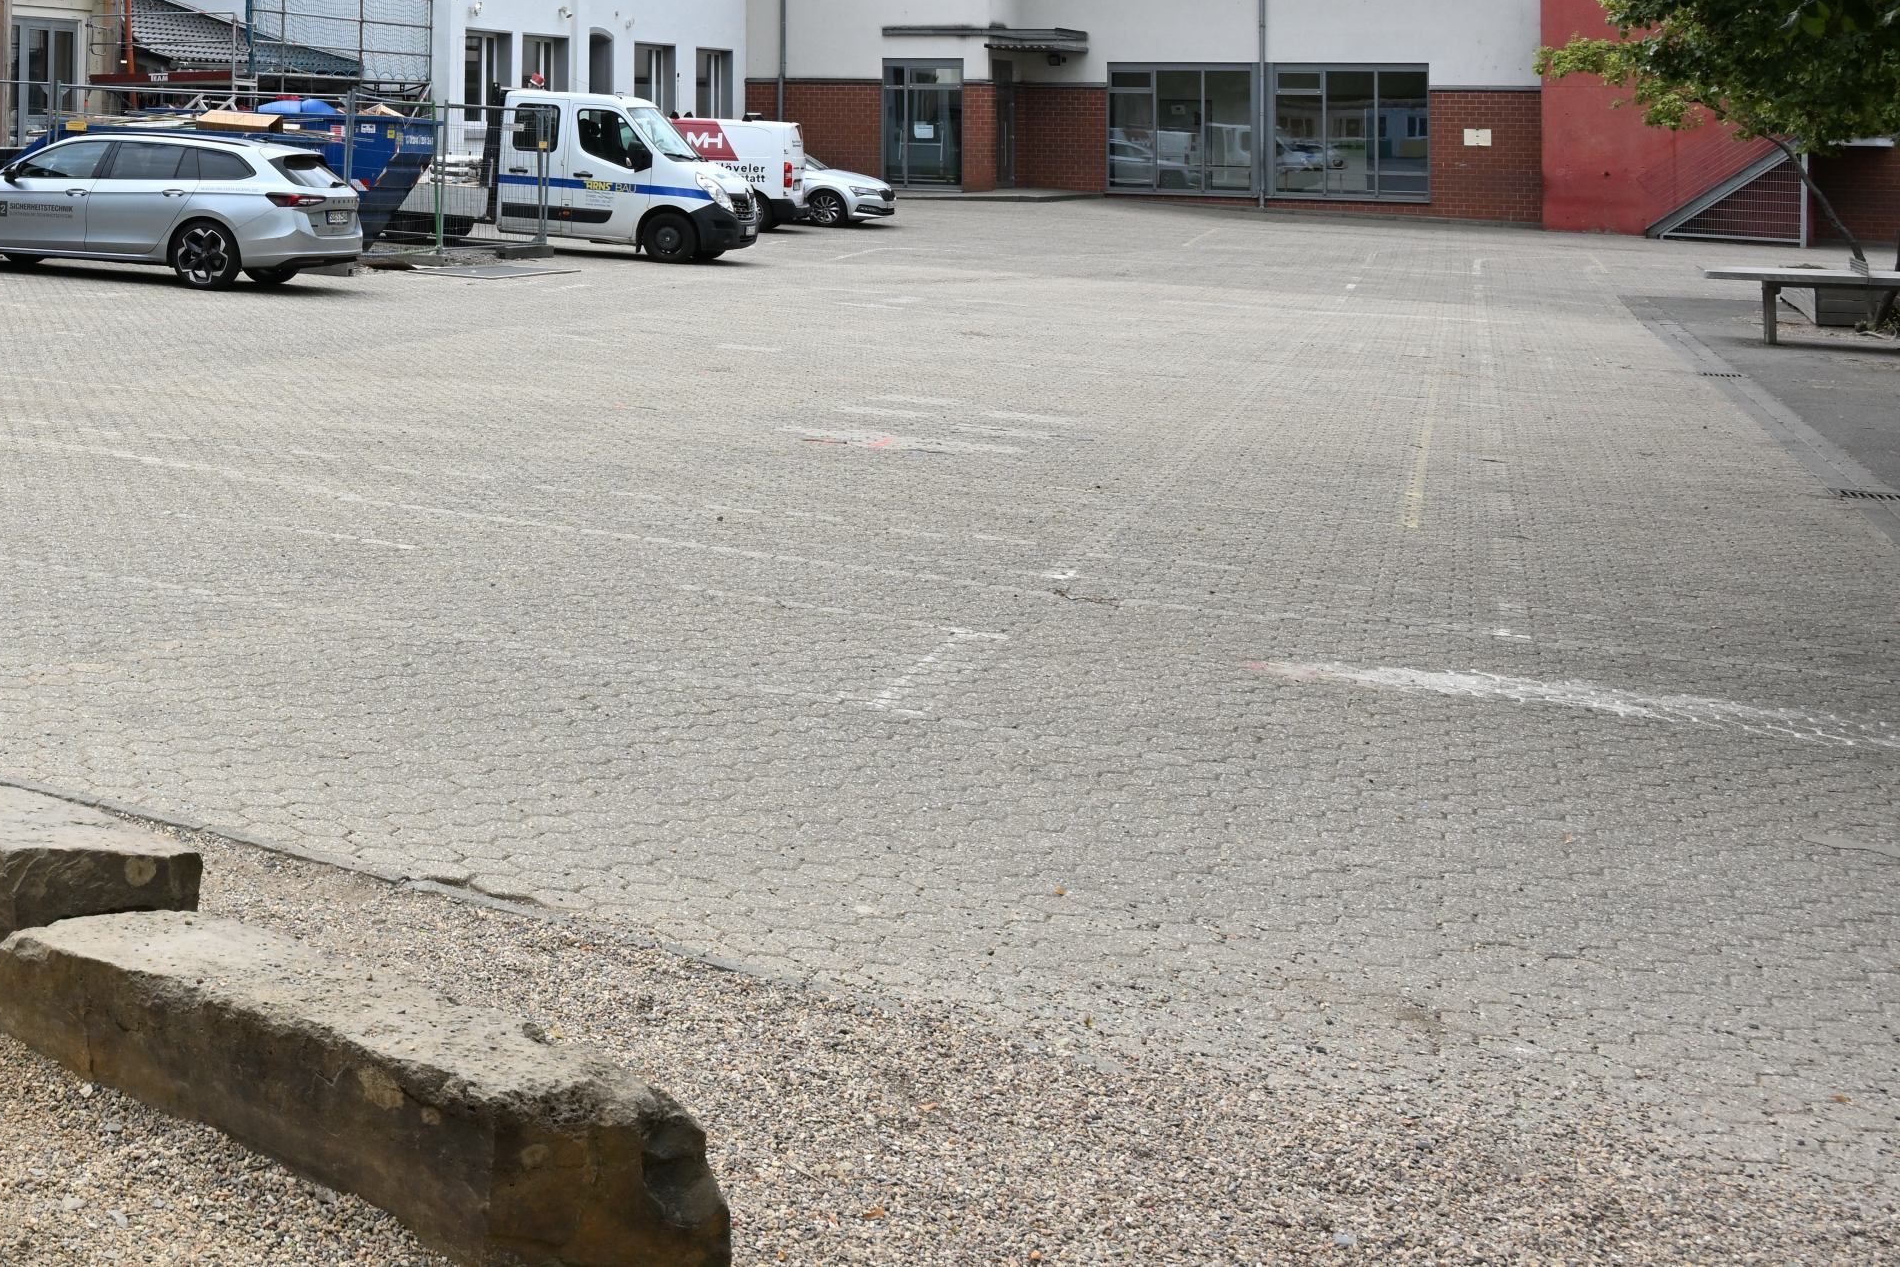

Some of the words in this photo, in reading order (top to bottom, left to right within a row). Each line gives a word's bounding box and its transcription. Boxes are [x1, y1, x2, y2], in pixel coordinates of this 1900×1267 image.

[148, 72, 169, 82] TEAM
[686, 132, 723, 149] MH
[584, 180, 612, 191] ARNS
[615, 183, 637, 194] BAU
[9, 202, 74, 213] SICHERHEITSTECHNIK
